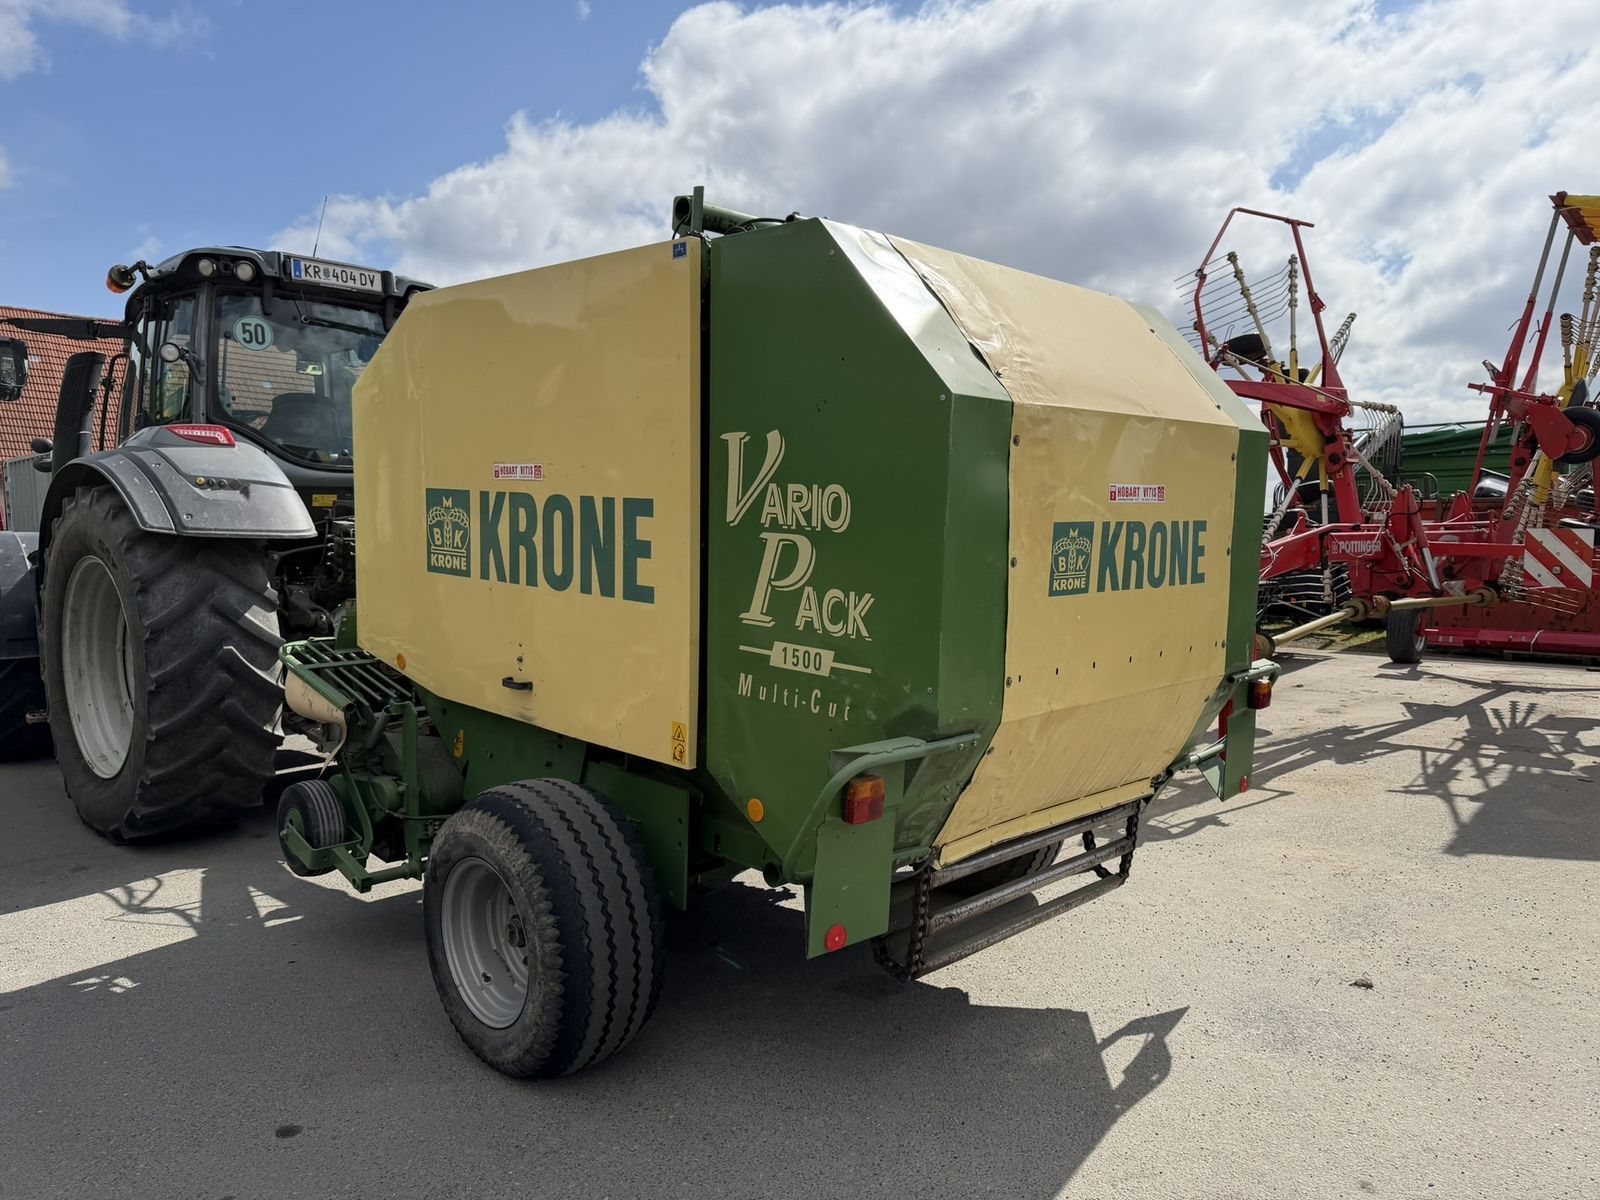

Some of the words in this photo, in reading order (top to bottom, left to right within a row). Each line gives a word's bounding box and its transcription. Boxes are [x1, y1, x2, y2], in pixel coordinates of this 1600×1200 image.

[304, 263, 321, 279] KR
[241, 322, 266, 345] 50
[719, 429, 852, 533] VARIO
[430, 553, 467, 571] KRONE
[479, 490, 655, 604] KRONE
[1096, 519, 1207, 593] KRONE
[738, 531, 875, 641] PACK
[1052, 577, 1087, 592] KRONE
[781, 646, 822, 672] 1500
[738, 672, 850, 721] Multi-Cut
